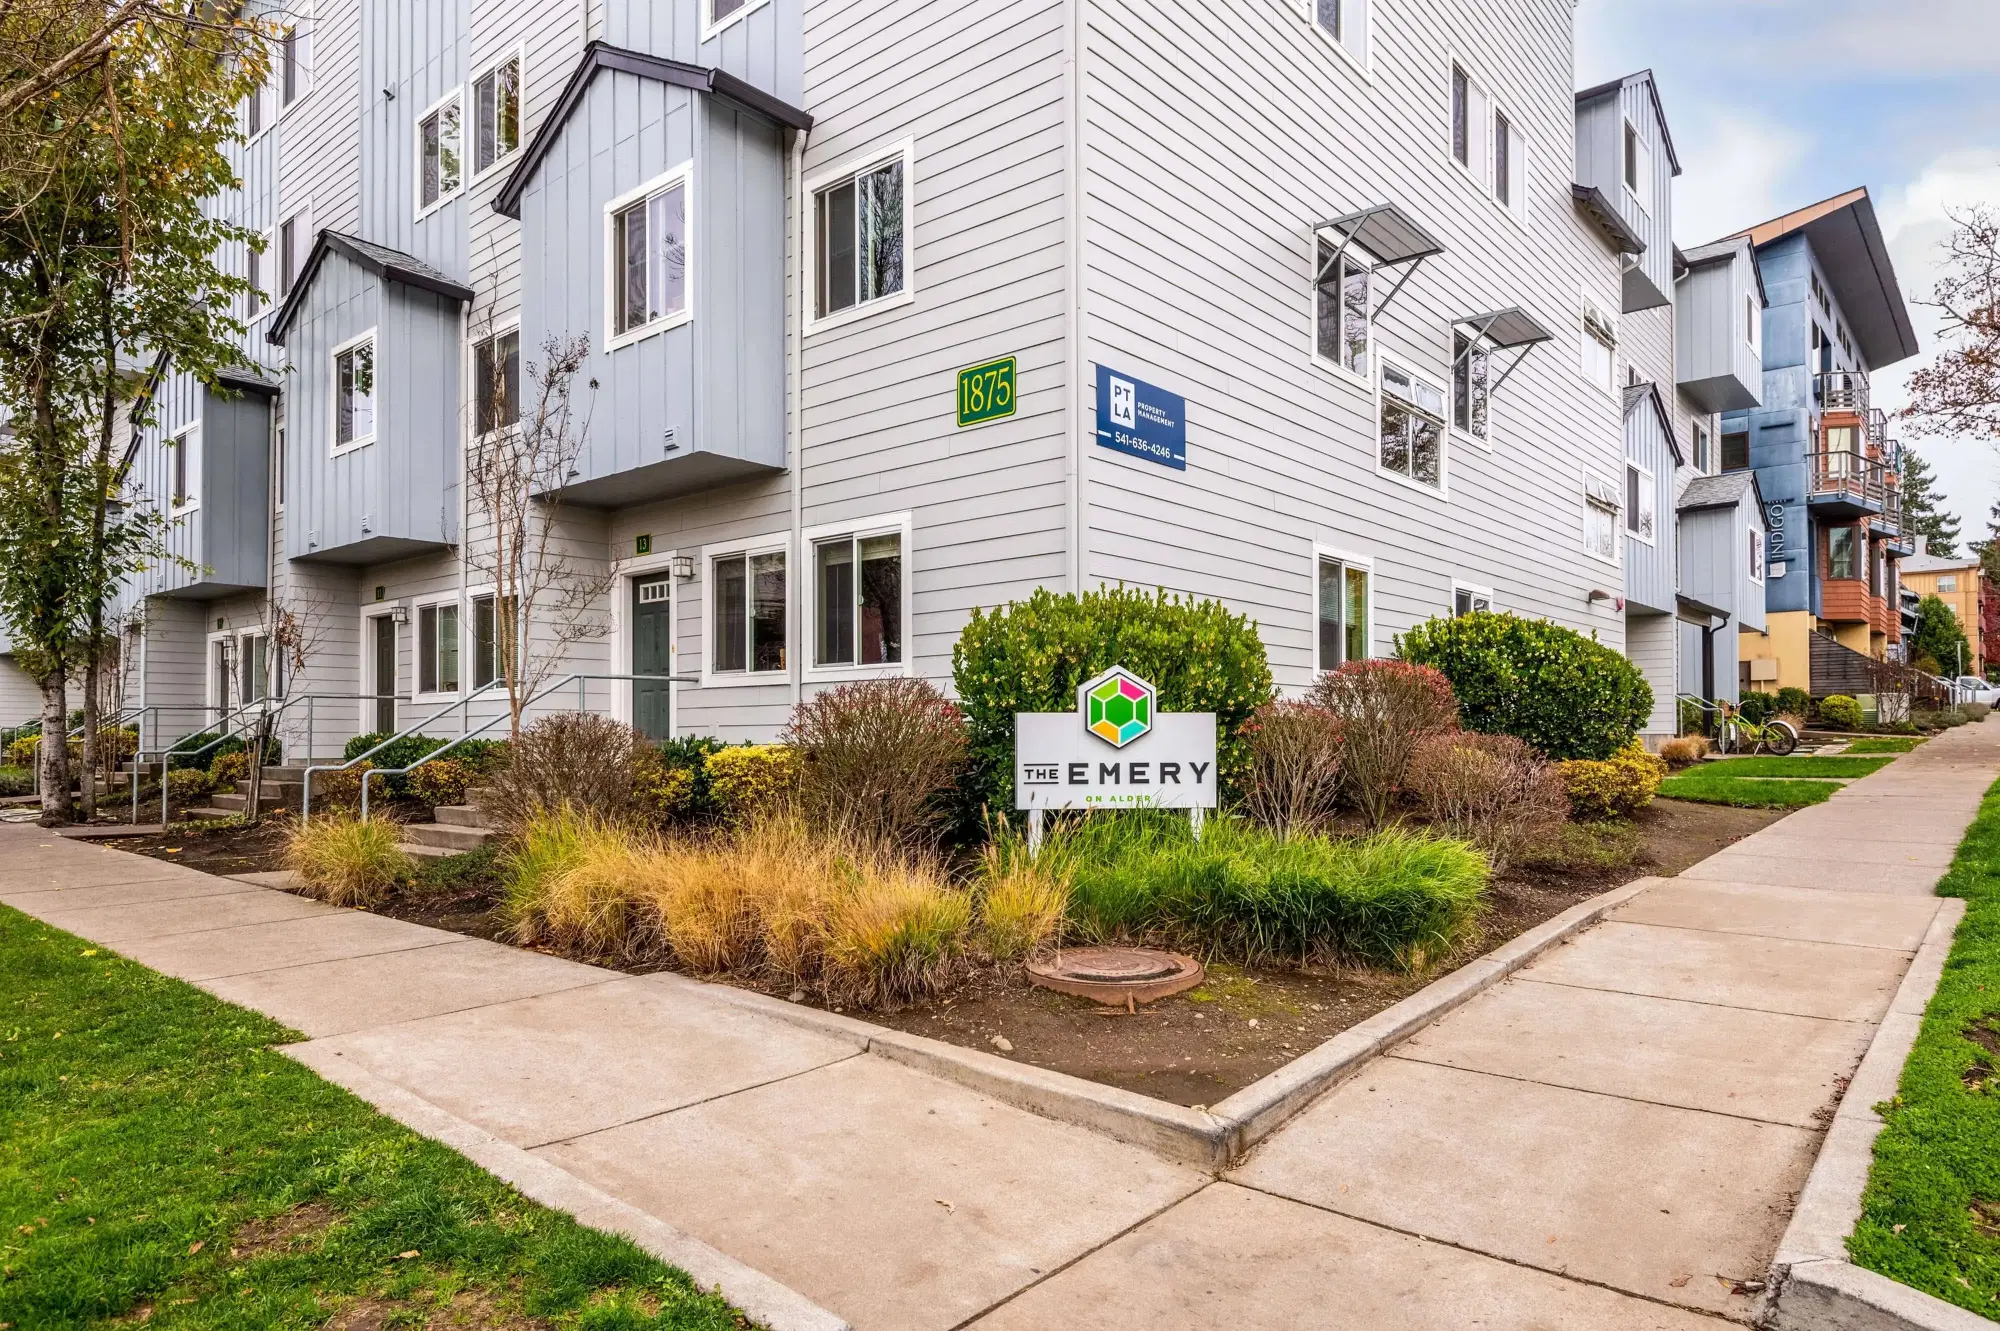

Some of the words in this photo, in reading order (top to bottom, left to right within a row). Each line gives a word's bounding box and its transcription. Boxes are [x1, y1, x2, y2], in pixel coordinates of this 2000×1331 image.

[962, 366, 1011, 415] 1875
[1114, 384, 1131, 402] PT
[1114, 403, 1131, 421] LA
[1137, 401, 1166, 417] PROPERTY
[1137, 409, 1175, 428] MANAGEMENT
[1115, 431, 1171, 459] 541-636-4246
[1770, 504, 1785, 559] INDIGO
[639, 538, 647, 551] 13
[1024, 769, 1059, 780] THE
[1068, 762, 1210, 785] EMERY
[1085, 795, 1102, 803] ON
